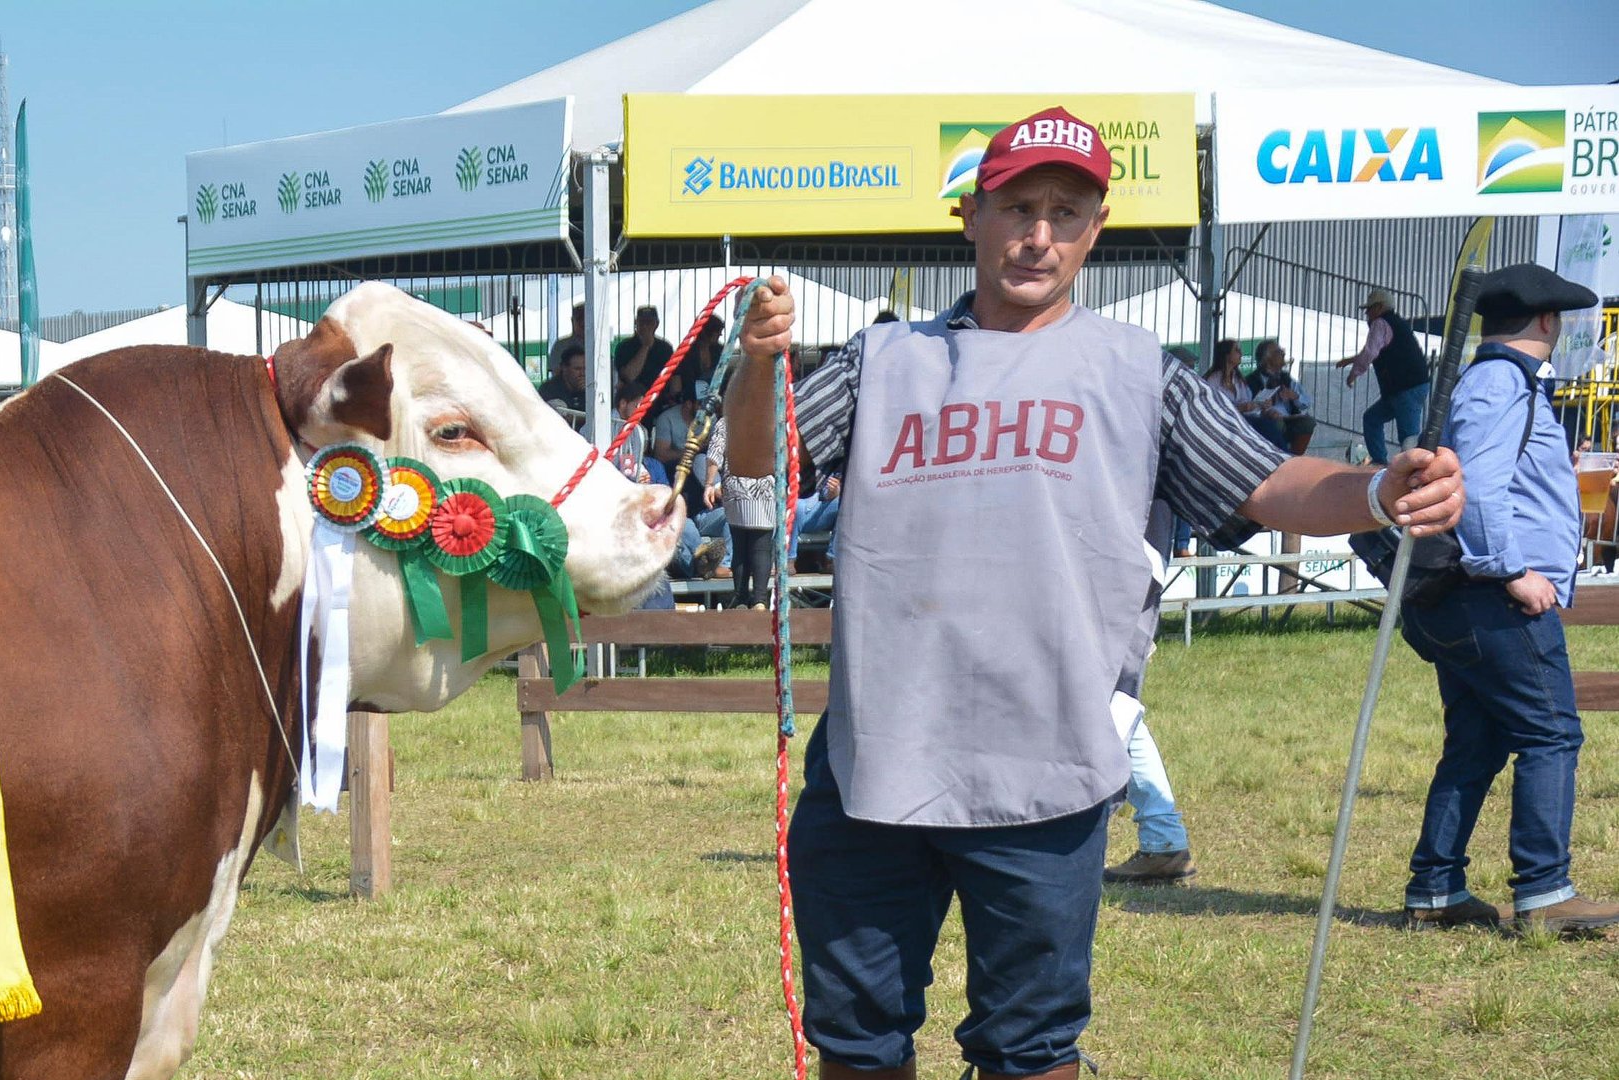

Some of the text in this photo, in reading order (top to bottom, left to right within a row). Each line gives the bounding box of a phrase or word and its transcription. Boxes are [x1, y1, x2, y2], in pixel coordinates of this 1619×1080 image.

[1574, 105, 1619, 131] PÁTR
[1010, 119, 1093, 152] ABHB
[1097, 121, 1160, 140] AMADA
[487, 144, 516, 164] CNA
[1109, 144, 1160, 180] SIL
[1256, 127, 1443, 184] CAIXA
[393, 158, 420, 177] CNA
[487, 163, 529, 186] SENAR
[720, 161, 901, 189] BANCO DO BRASIL
[305, 171, 330, 188] CNA
[393, 176, 432, 197] SENAR
[1570, 183, 1617, 195] GOVER
[222, 183, 246, 200] CNA
[305, 188, 342, 208] SENAR
[1110, 185, 1160, 197] EDERAL
[222, 200, 257, 219] SENAR
[880, 399, 1085, 474] ABHB
[927, 468, 972, 481] BRASILEIRA
[974, 467, 985, 476] DE
[986, 463, 1033, 476] HEREFORD
[1216, 564, 1251, 577] ENR
